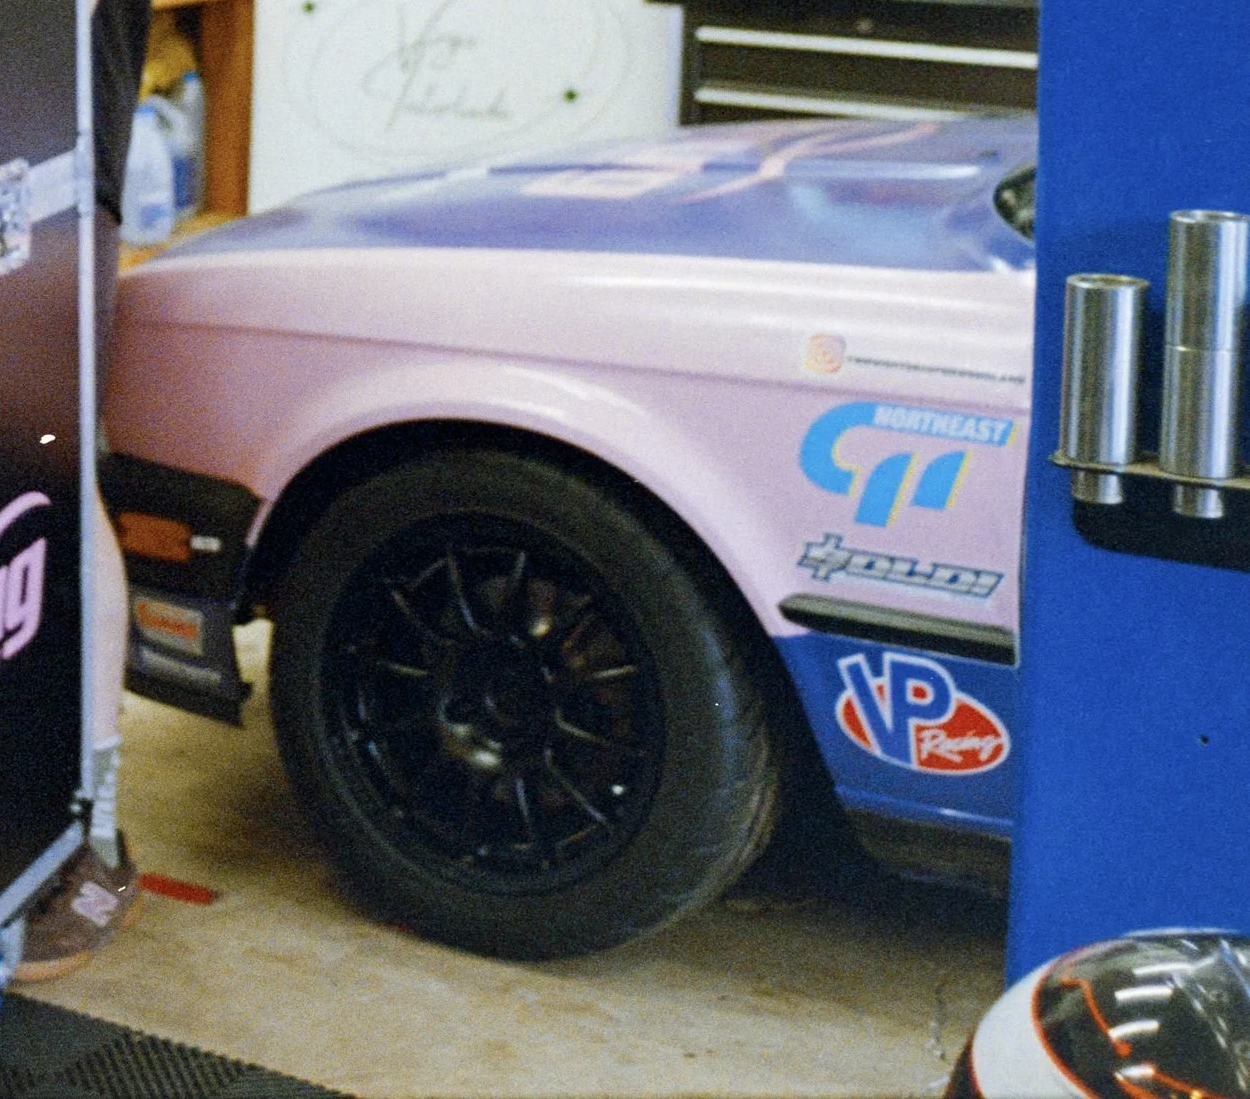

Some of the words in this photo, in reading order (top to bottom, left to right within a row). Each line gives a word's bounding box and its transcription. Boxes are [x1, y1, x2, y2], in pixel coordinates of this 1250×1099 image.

[872, 404, 1008, 446] NORTHEAST
[836, 651, 957, 766] VP
[919, 728, 1004, 764] Racing
